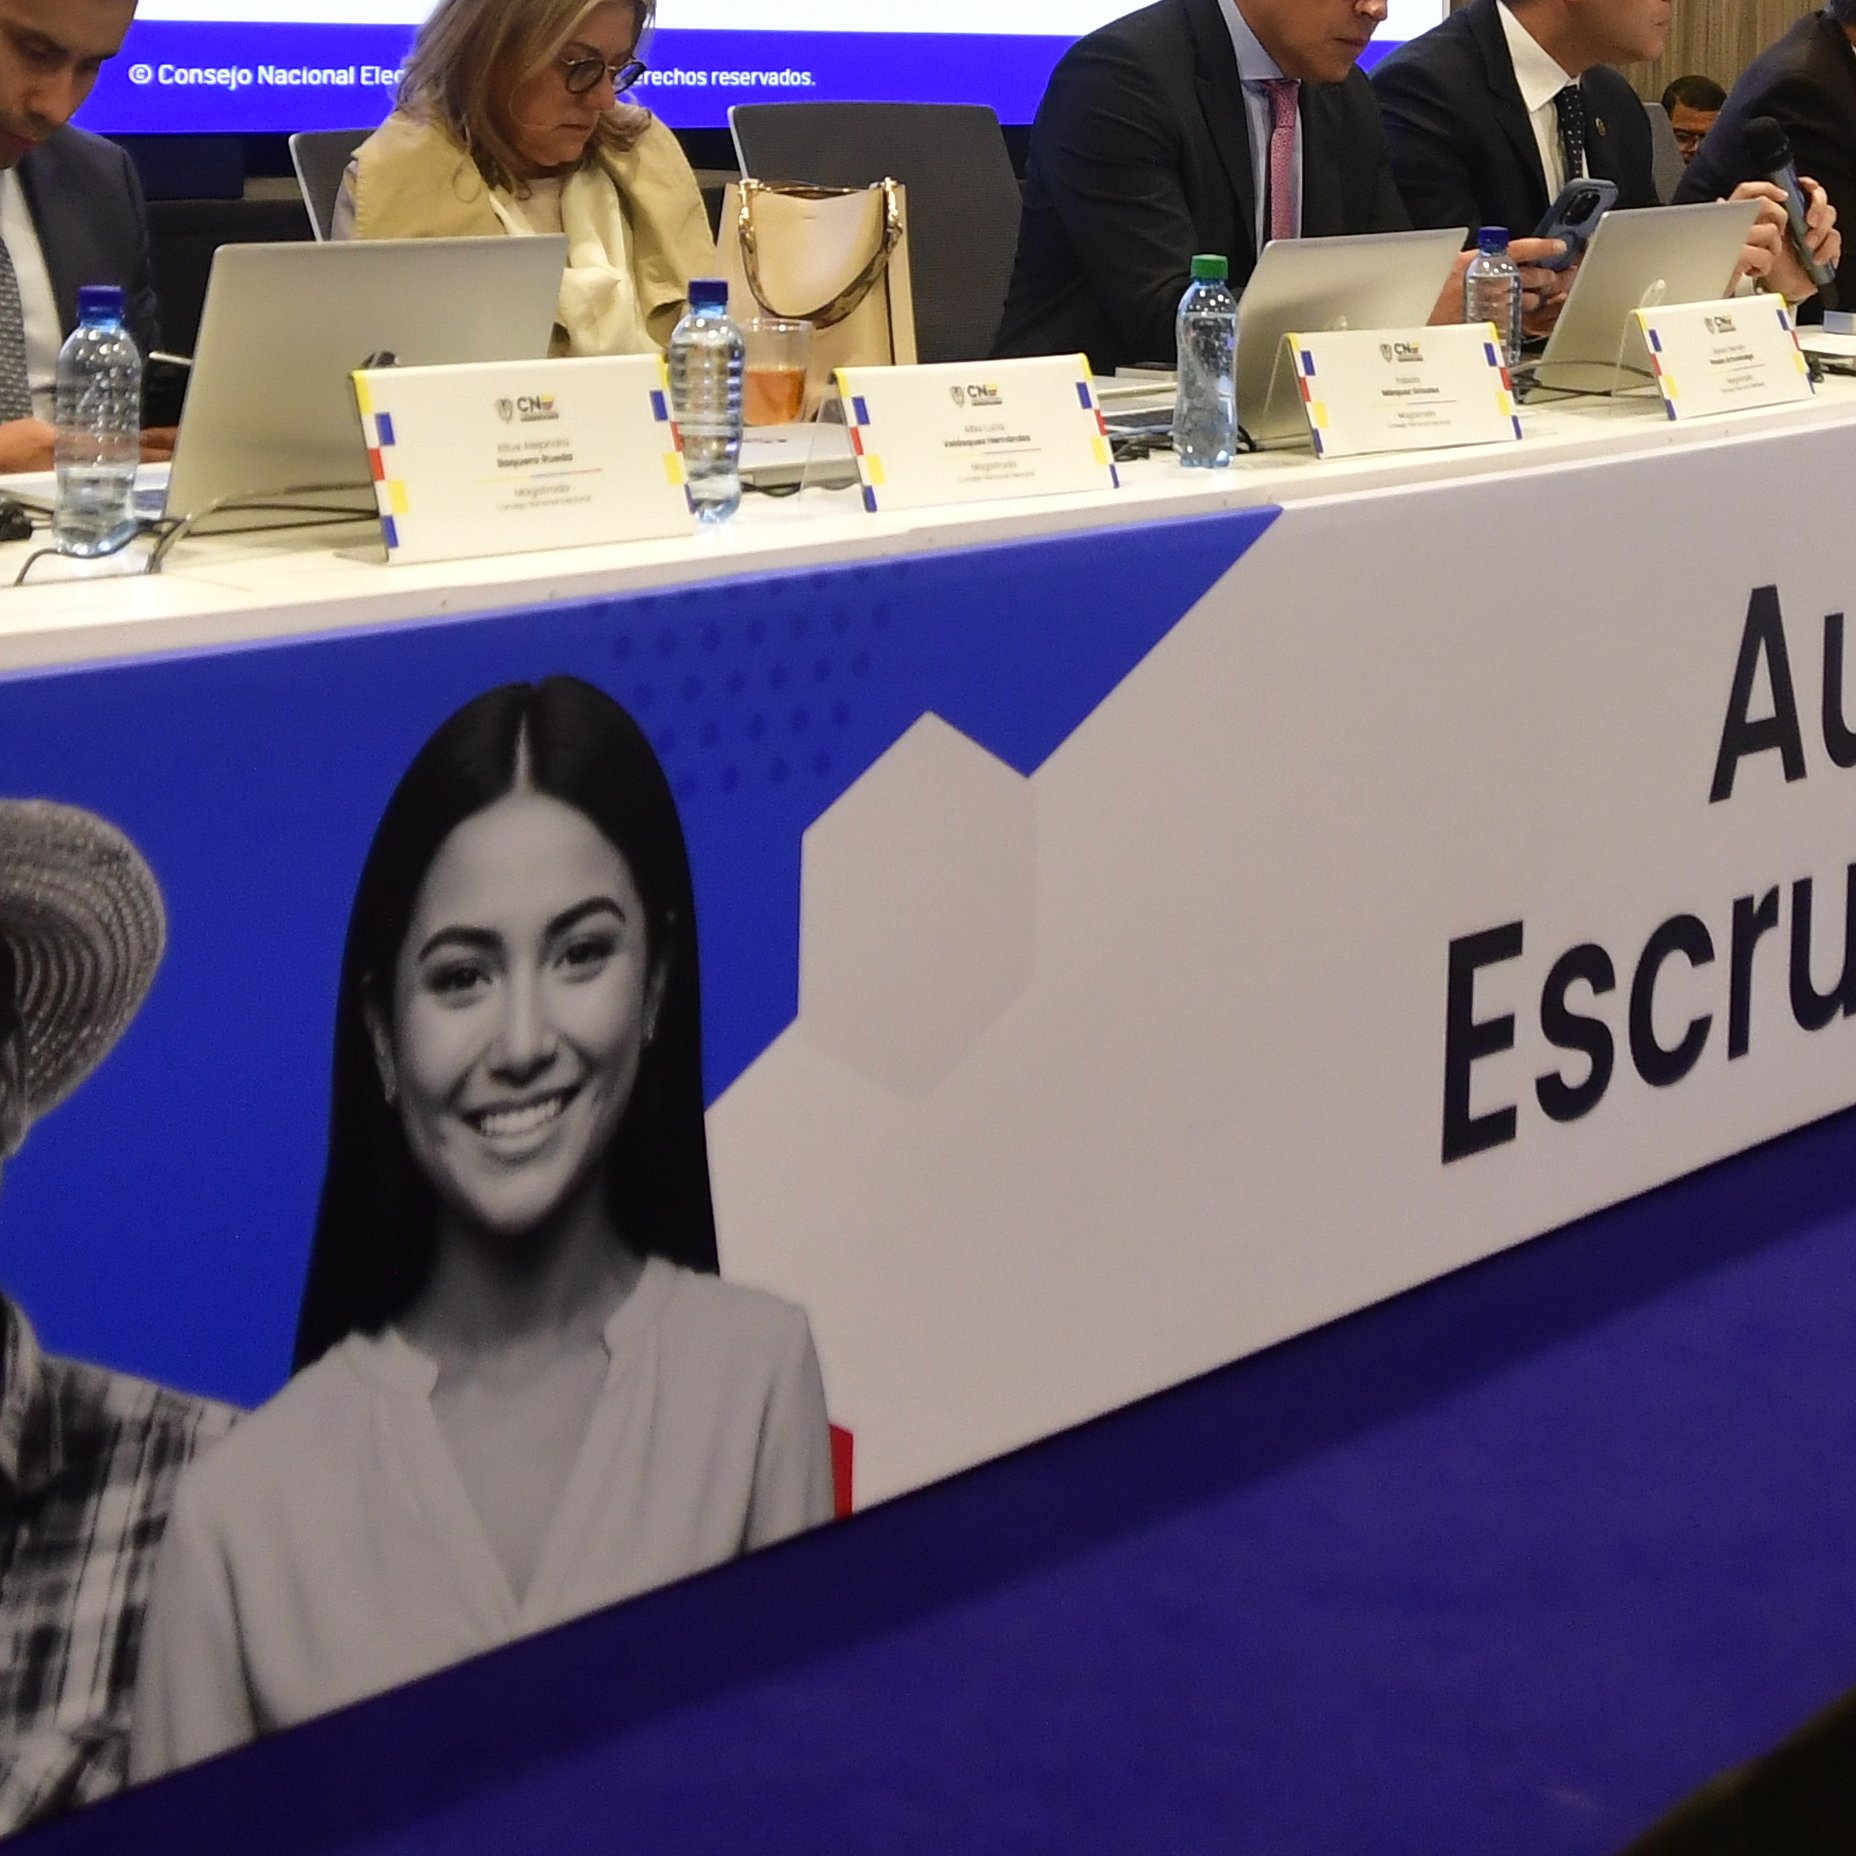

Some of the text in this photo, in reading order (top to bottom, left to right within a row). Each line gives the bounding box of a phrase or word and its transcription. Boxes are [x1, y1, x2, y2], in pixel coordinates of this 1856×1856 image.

[157, 63, 253, 92] Consejo
[257, 64, 355, 86] Nacional
[711, 67, 817, 87] reservados.
